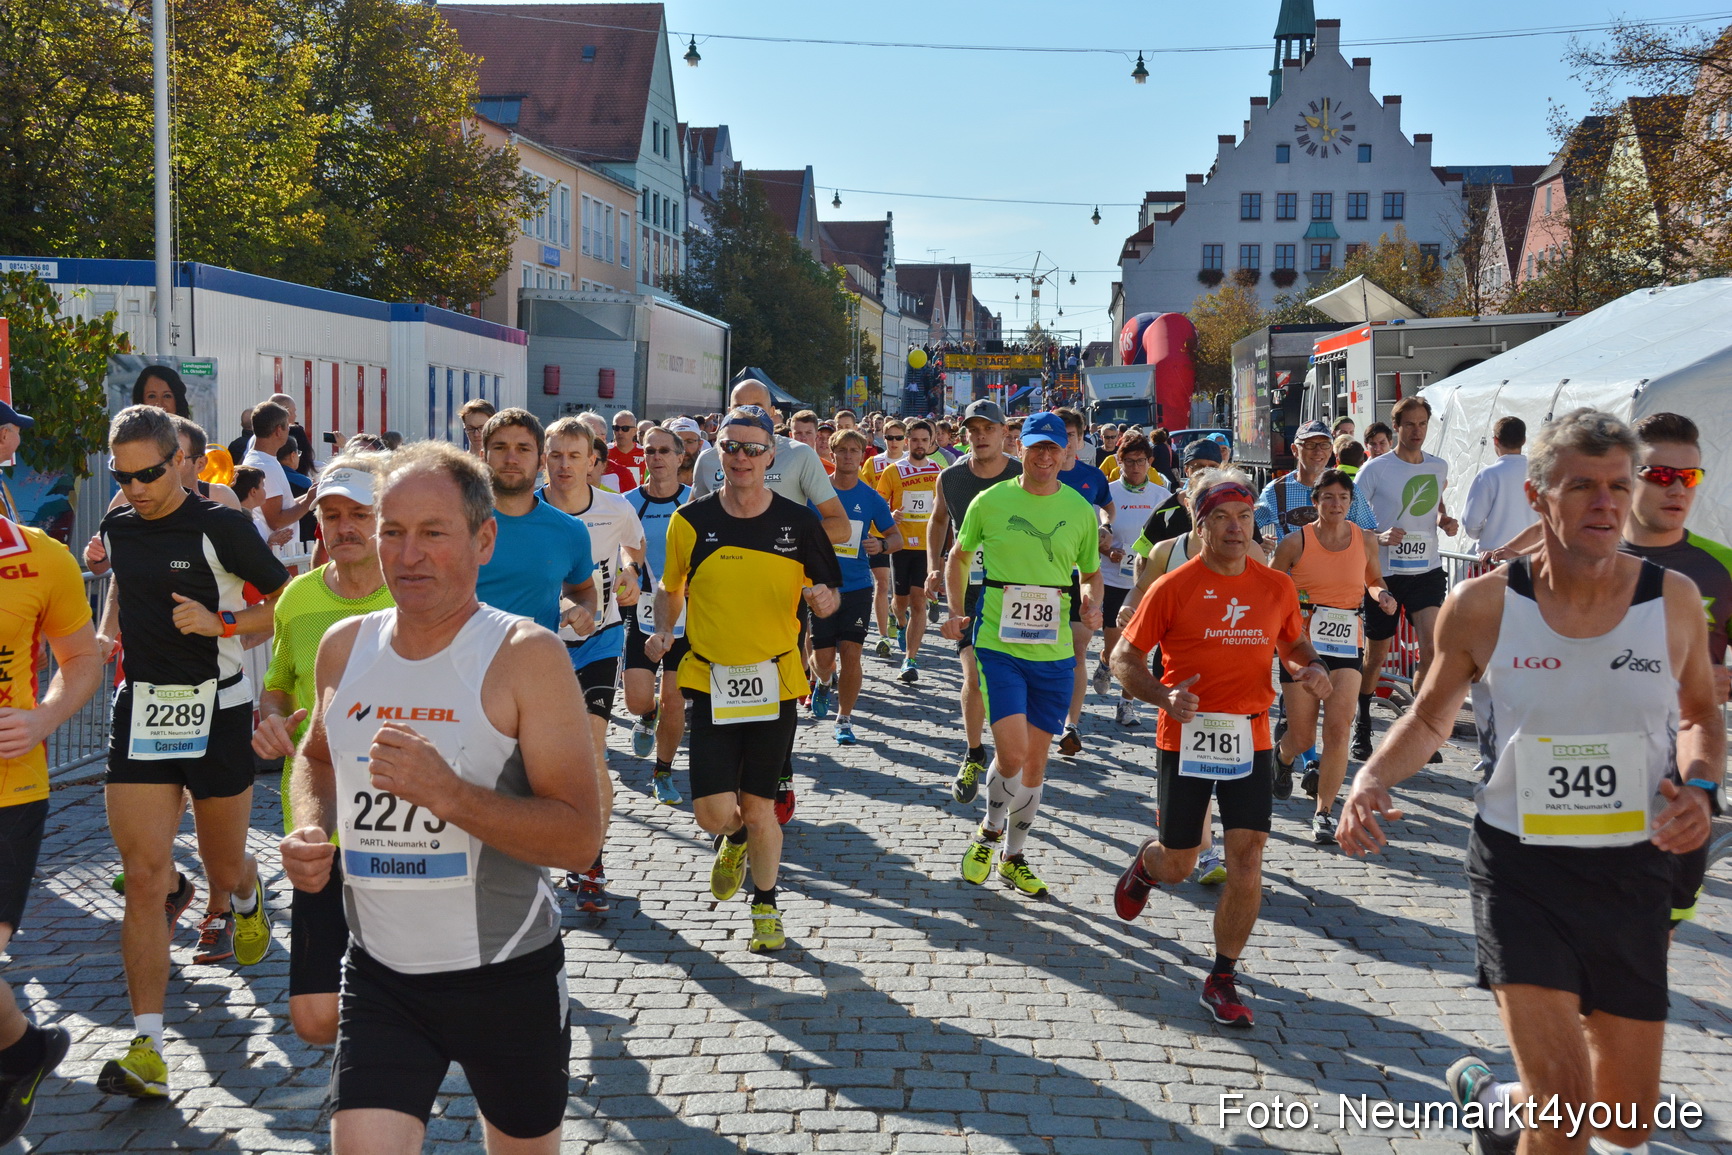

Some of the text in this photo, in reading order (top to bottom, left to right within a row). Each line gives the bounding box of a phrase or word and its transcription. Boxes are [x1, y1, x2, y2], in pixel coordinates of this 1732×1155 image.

[976, 356, 1010, 366] START
[901, 478, 921, 487] MAX
[912, 499, 924, 510] 79
[774, 544, 798, 553] Burgthann
[1395, 542, 1426, 555] 3049
[1011, 602, 1053, 622] 2138
[1020, 630, 1040, 639] Horst
[1203, 628, 1263, 639] funrunners
[1317, 621, 1352, 638] 2205
[1222, 636, 1269, 645] neumarkt
[1513, 656, 1562, 670] LGO
[1627, 657, 1661, 673] asics
[729, 665, 758, 674] BOCK
[727, 677, 763, 697] 320
[156, 690, 194, 698] BOCK
[145, 703, 206, 727] 2289
[376, 706, 460, 722] KLEBL
[1203, 719, 1235, 727] BOCK
[155, 741, 194, 752] Carsten
[1192, 731, 1240, 754] 2181
[1552, 744, 1609, 756] BOCK
[1200, 764, 1237, 774] Hartmut
[1548, 764, 1617, 799] 349
[360, 838, 427, 848] PARTL Neumarkt
[370, 857, 427, 875] Roland
